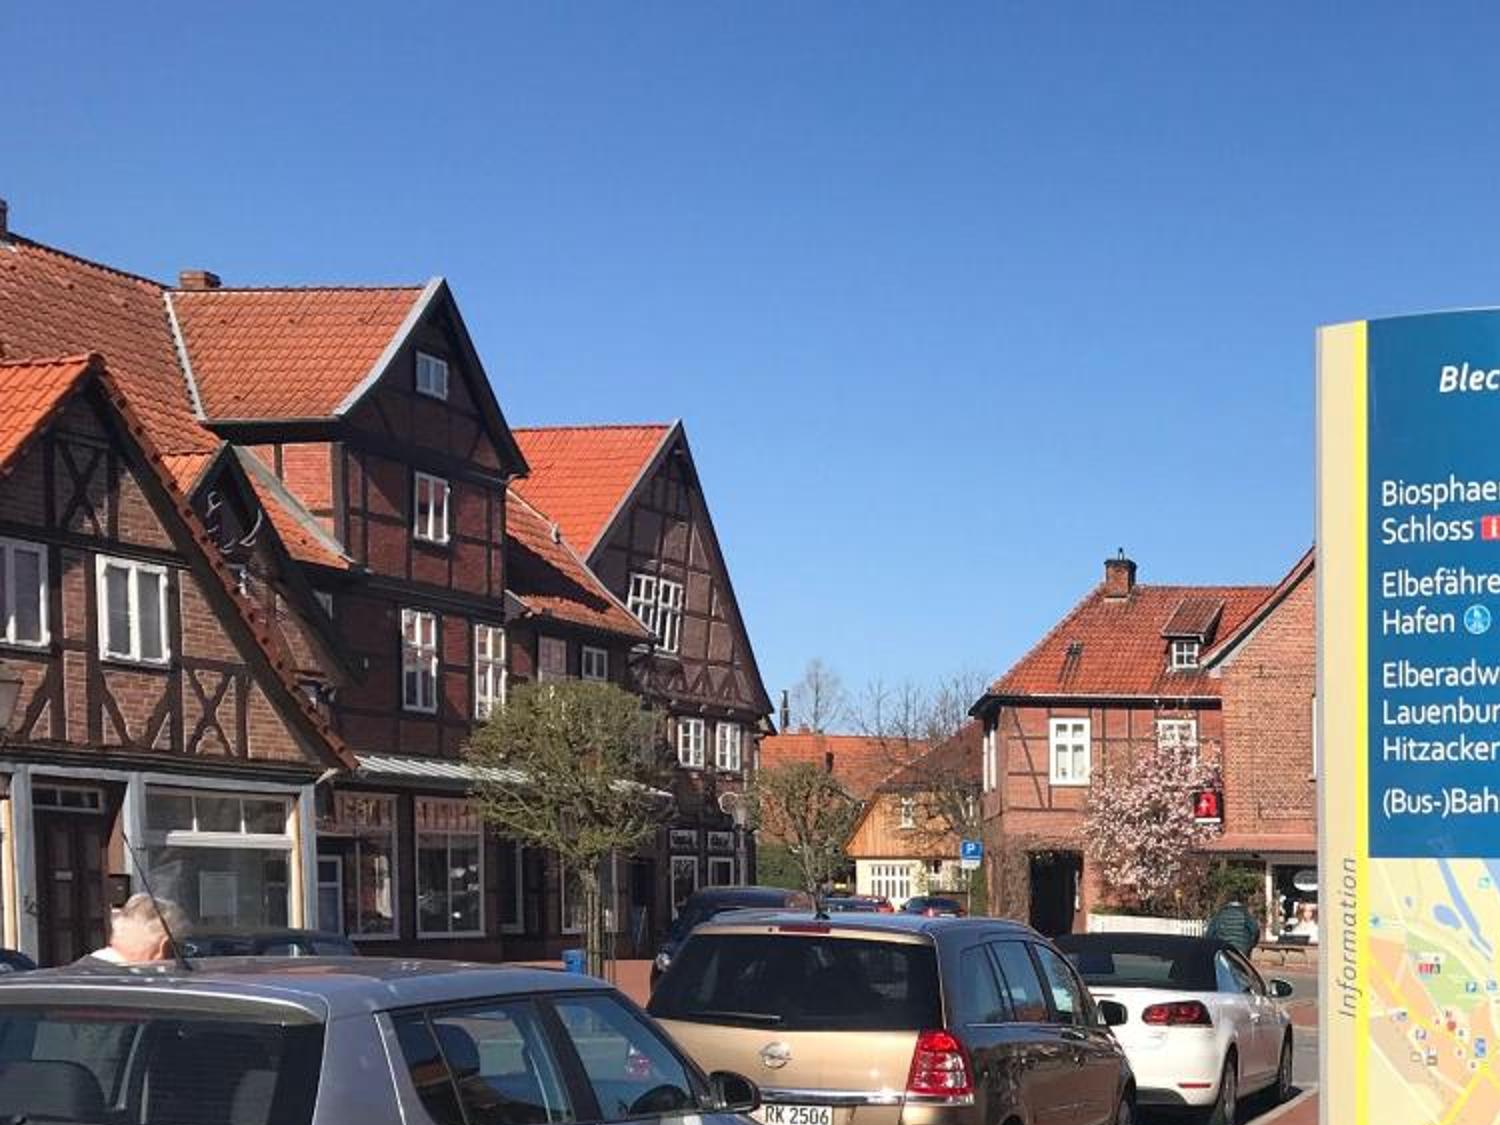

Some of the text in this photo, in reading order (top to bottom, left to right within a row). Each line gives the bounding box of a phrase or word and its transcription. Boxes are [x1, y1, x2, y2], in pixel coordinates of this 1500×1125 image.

[1382, 516, 1475, 545] Schloss
[1383, 605, 1455, 635] Hafen
[1336, 857, 1363, 1018] Information
[764, 1104, 785, 1124] RK
